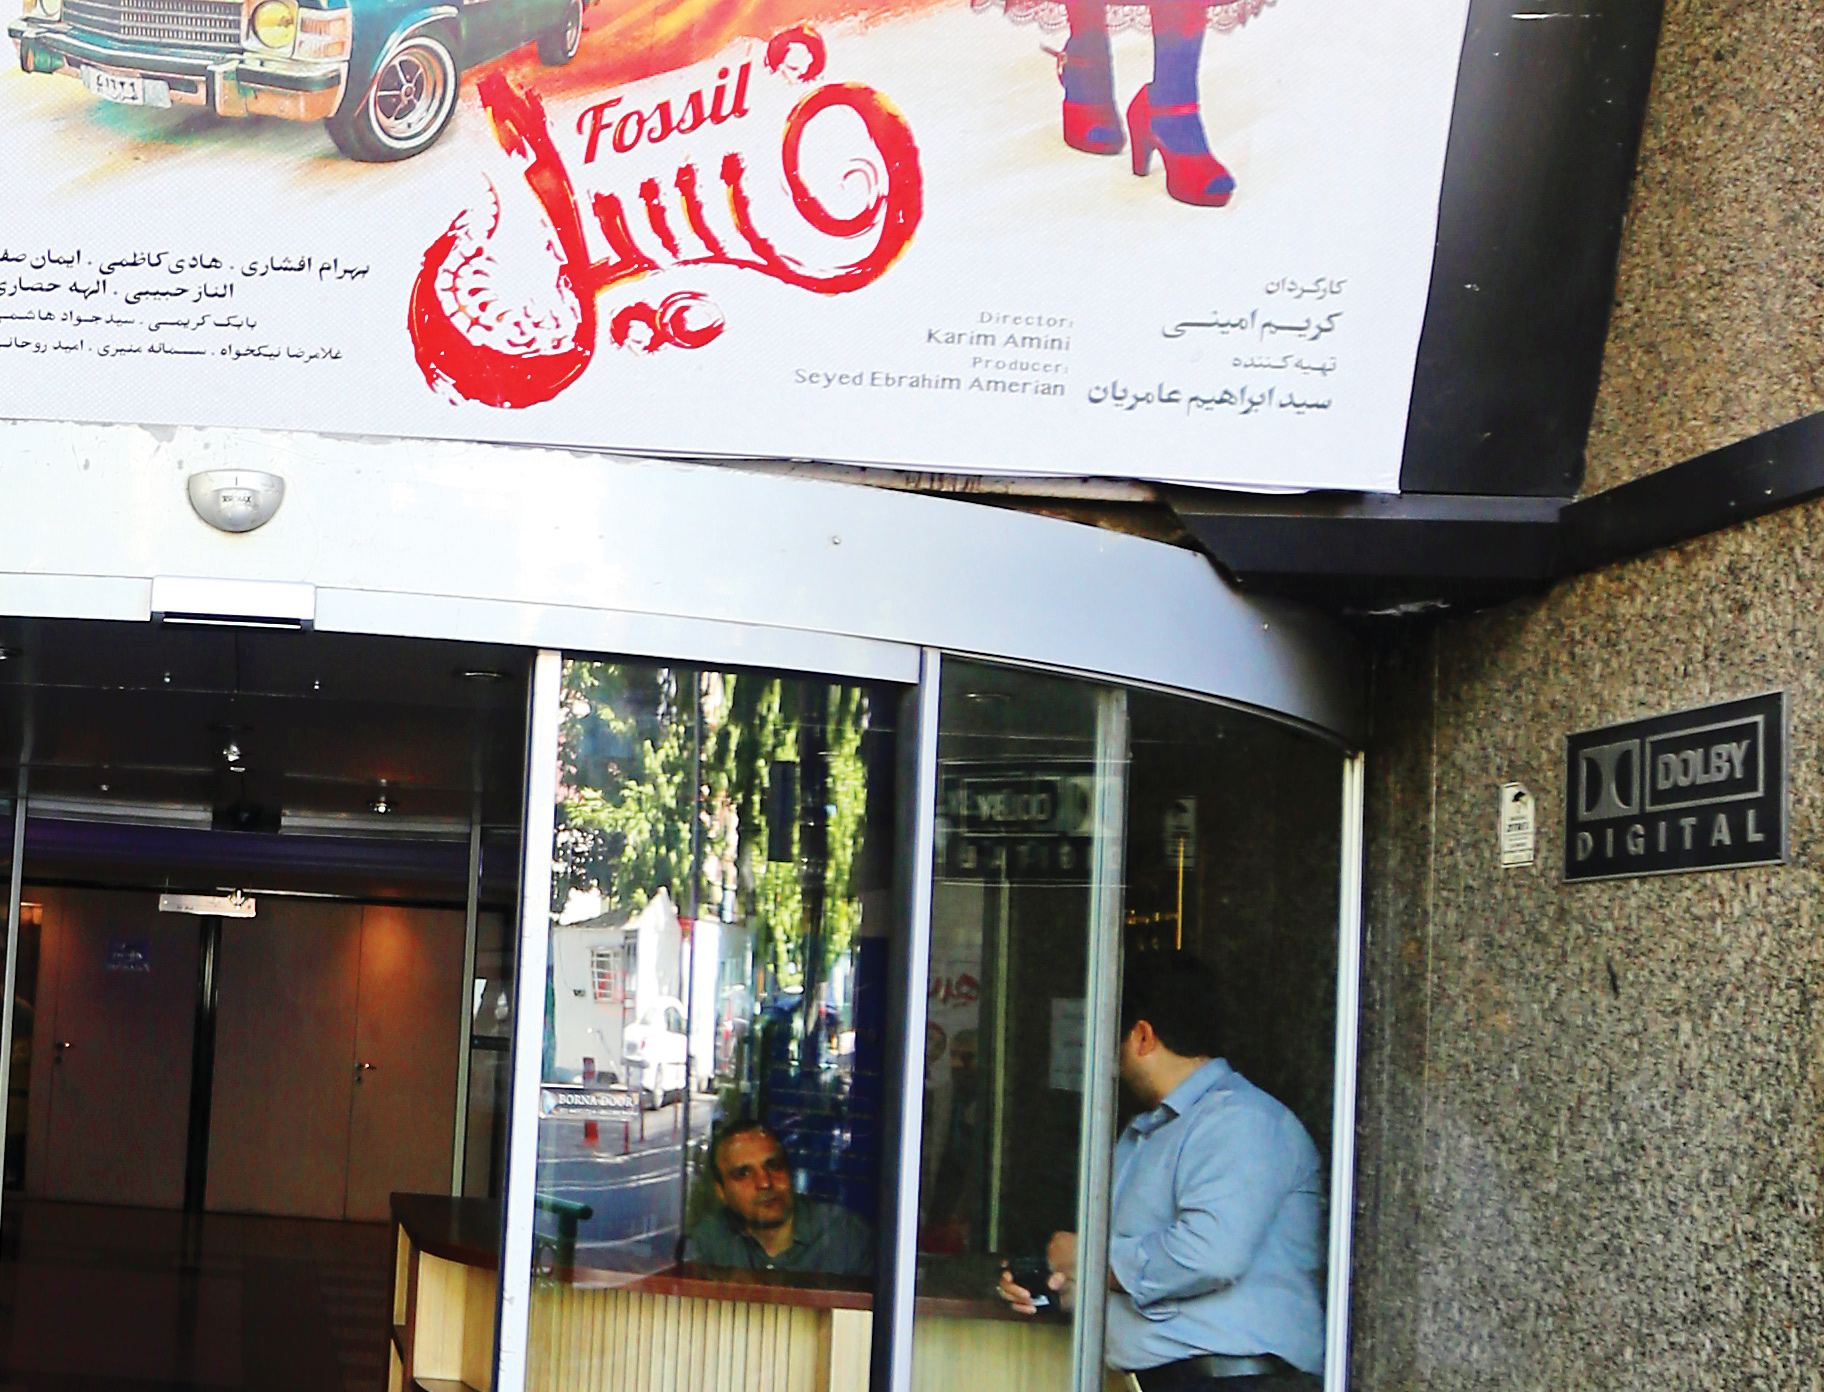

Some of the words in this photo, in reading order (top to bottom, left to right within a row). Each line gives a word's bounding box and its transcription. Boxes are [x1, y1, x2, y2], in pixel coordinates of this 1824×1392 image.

[576, 62, 754, 164] Fossil
[407, 26, 924, 409] فسیل
[30, 249, 82, 269] ایمان
[99, 251, 169, 275] کاظمی
[167, 253, 223, 274] هادی
[241, 255, 312, 277] افشاری
[318, 257, 371, 281] بهرام
[68, 279, 107, 300] الهه
[125, 286, 189, 304] حبیبی
[192, 282, 234, 303] الناز
[1264, 277, 1347, 300] کارگردان
[61, 310, 102, 326] جواد
[105, 314, 135, 327] سید
[148, 314, 211, 331] کریمی
[213, 314, 257, 330] بابک
[979, 311, 1074, 329] Director:
[1162, 308, 1258, 338] امینی
[1260, 311, 1344, 342] کریم
[52, 339, 84, 352] امید
[148, 342, 206, 356] سمانه
[926, 328, 996, 347] Karim
[1003, 333, 1071, 351] Amini
[97, 344, 143, 357] منیری
[220, 343, 282, 361] نیکخواه
[286, 345, 343, 363] غلامرضا
[971, 356, 1070, 374] Producer:
[794, 368, 863, 388] Seyed
[870, 371, 962, 391] Ebrahim
[968, 376, 1066, 396] Amerian
[1088, 379, 1182, 411] عامریان
[1186, 385, 1275, 416] ابراهیم
[1279, 391, 1332, 415] سید
[1657, 740, 1751, 791] DOLBY
[1576, 809, 1765, 862] DIGITAL
[558, 1093, 597, 1105] BORNA
